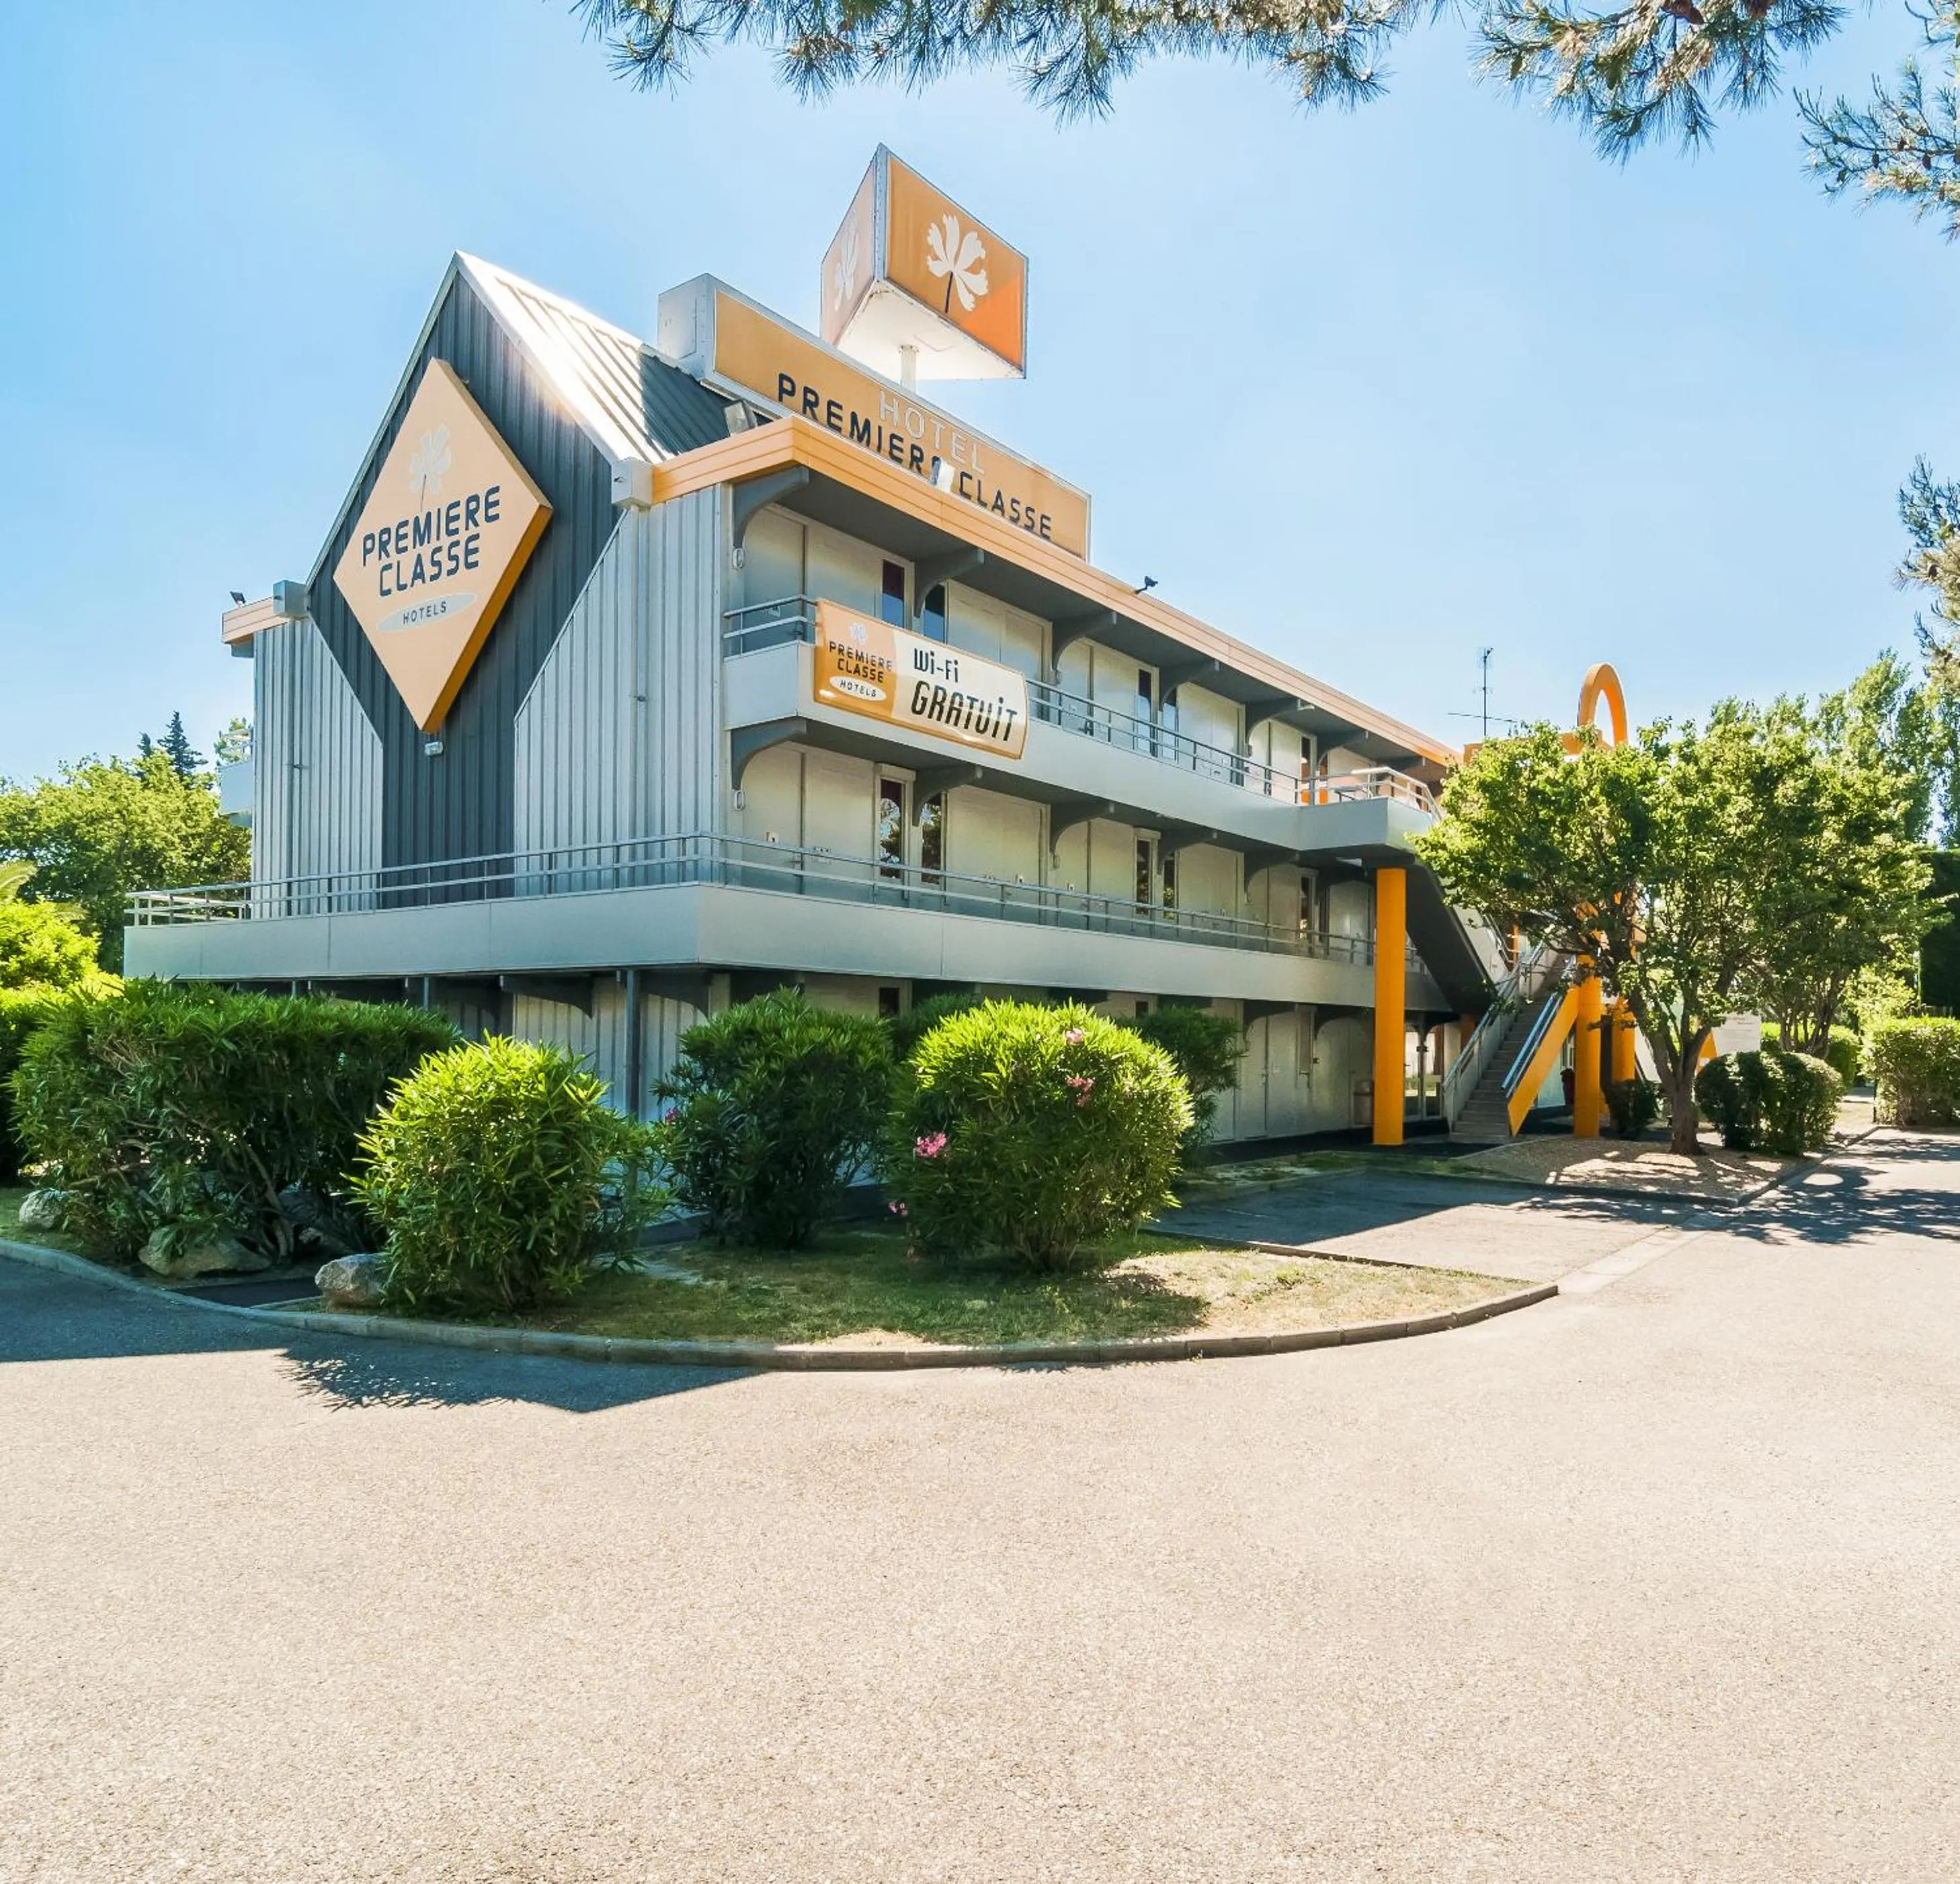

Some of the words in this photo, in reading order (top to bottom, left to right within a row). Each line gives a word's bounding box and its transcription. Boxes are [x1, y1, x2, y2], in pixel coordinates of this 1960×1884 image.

[879, 389, 985, 475] HOTEL
[958, 470, 1052, 540] CLASSE
[362, 485, 501, 567] PREMIERE
[379, 532, 481, 598] CLASSE
[403, 600, 448, 625] HOTELS
[829, 640, 893, 672] PREMIERE
[837, 657, 884, 684] CLASSE
[913, 647, 959, 683] Wi-Fi
[840, 679, 877, 698] HOTELS
